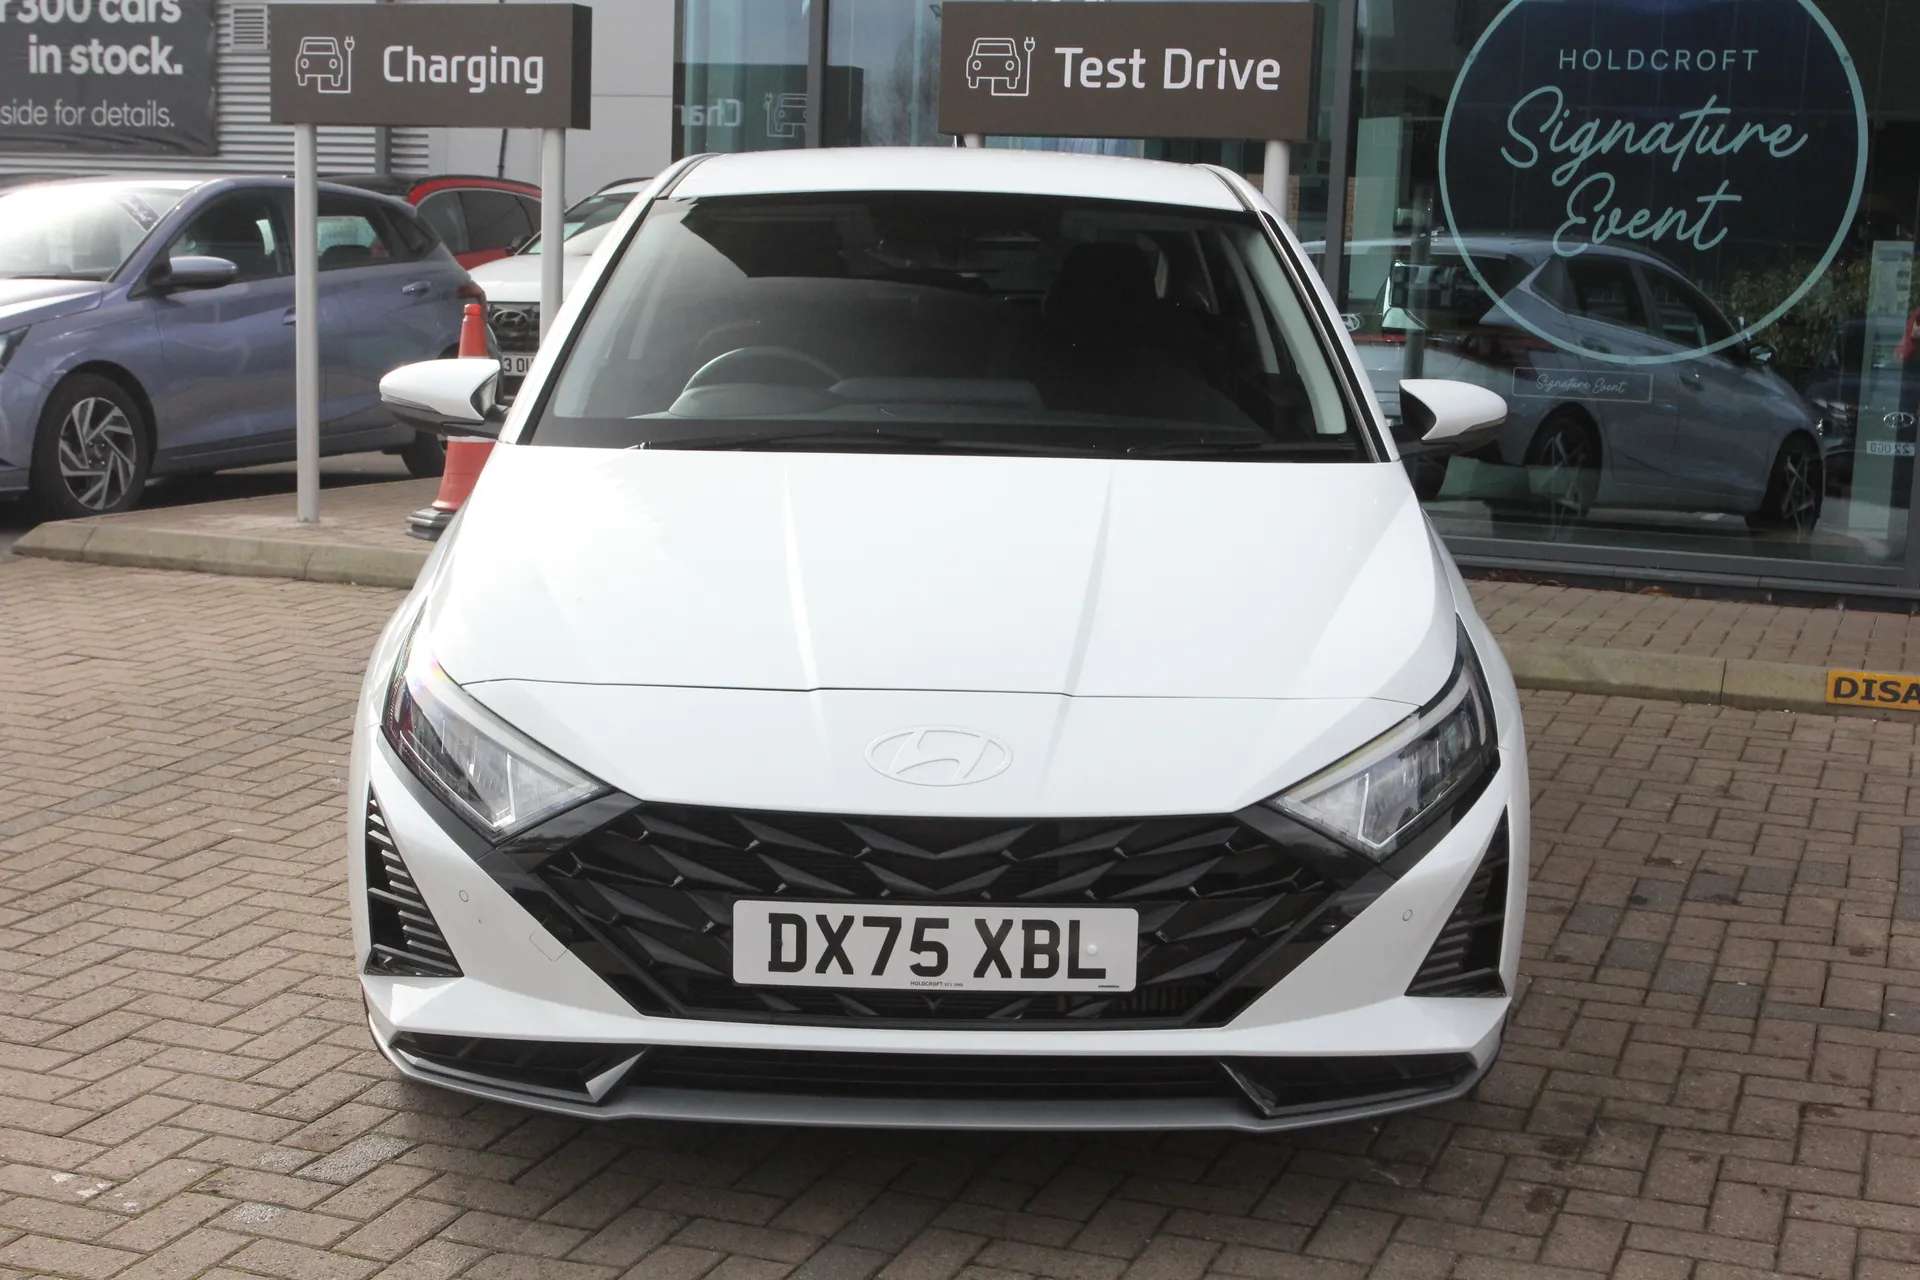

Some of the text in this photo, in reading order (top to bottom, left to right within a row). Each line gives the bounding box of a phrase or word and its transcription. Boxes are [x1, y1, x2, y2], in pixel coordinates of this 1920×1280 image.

[16, 0, 92, 23] 300
[98, 0, 182, 23] cars
[28, 34, 183, 75] in stock.
[383, 45, 544, 94] Charging
[1054, 47, 1281, 91] Test Drive
[1558, 48, 1760, 71] HOLDCROFT
[0, 98, 175, 128] side for details.
[1500, 85, 1809, 187] Signature
[1552, 171, 1743, 258] Event
[1535, 373, 1628, 394] Signature Event
[1833, 676, 1920, 704] DISA
[767, 912, 1107, 980] DX75 XBL
